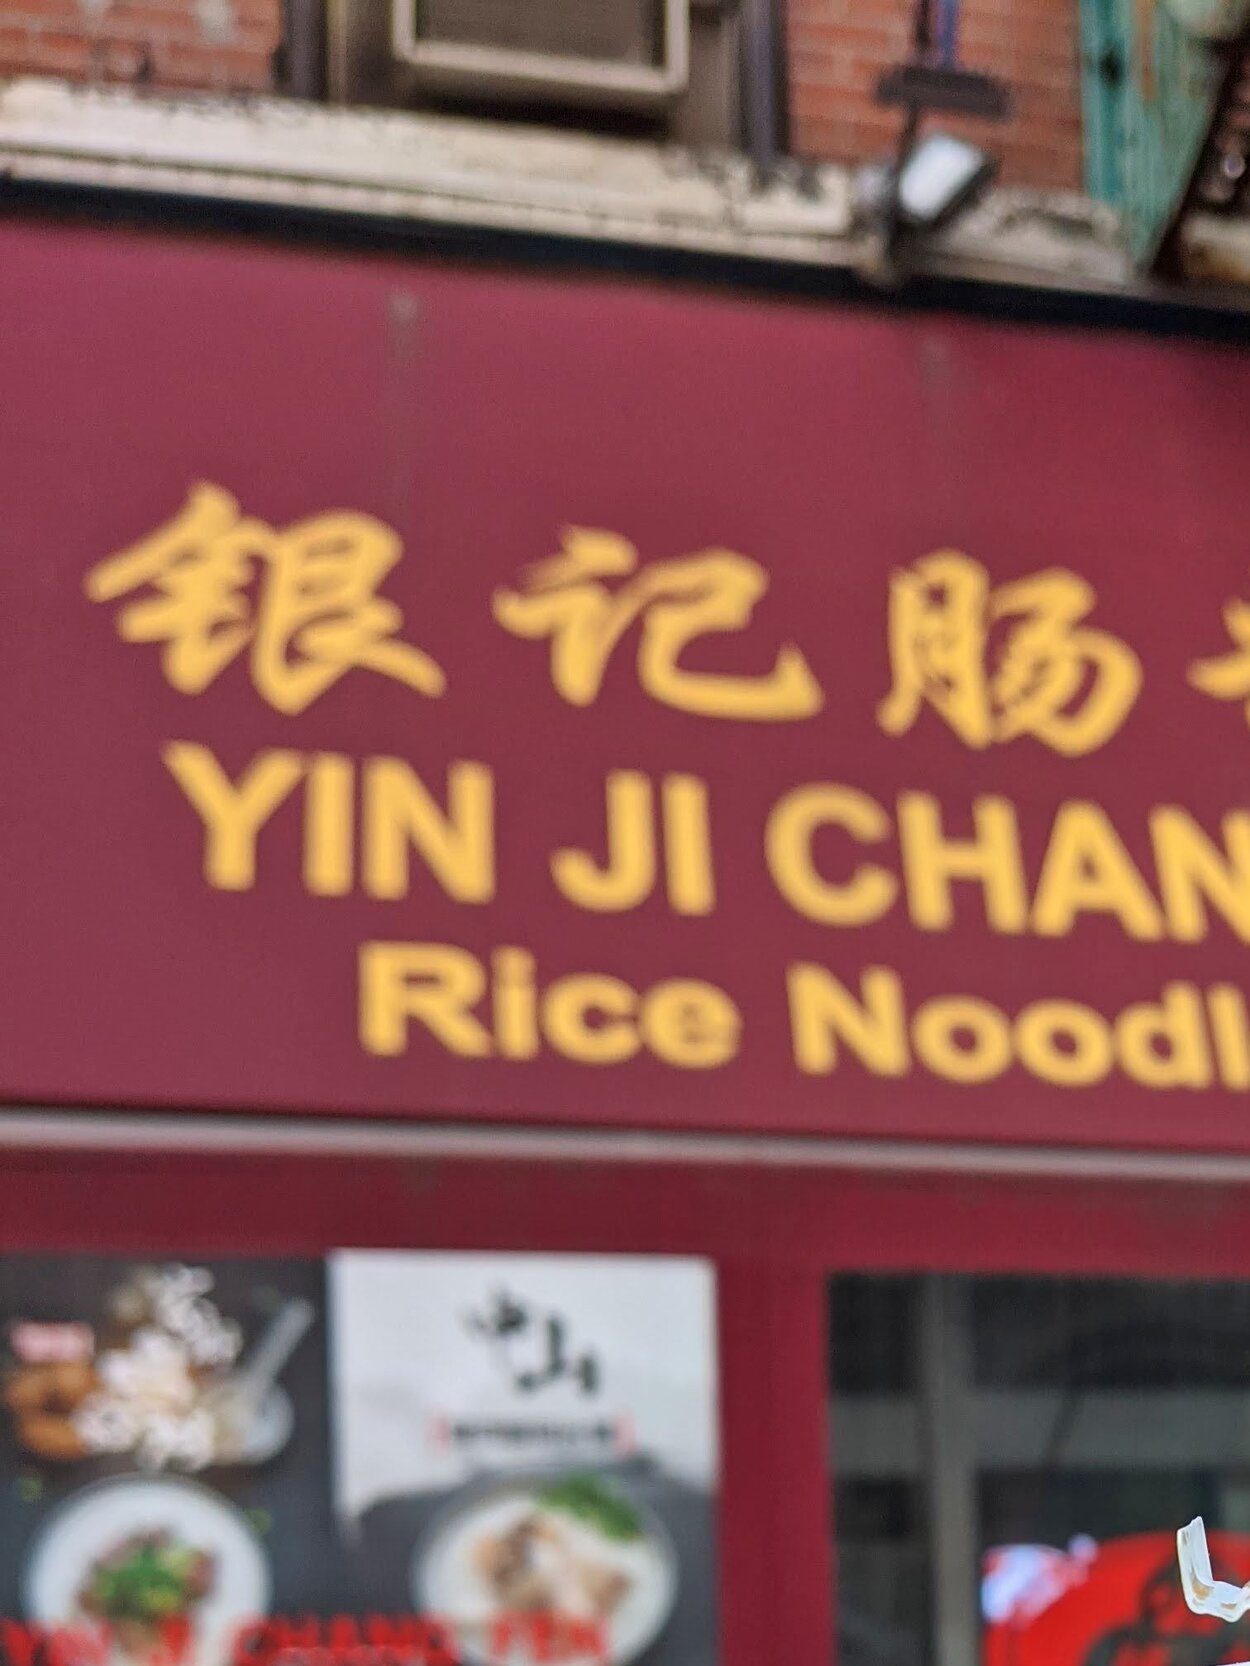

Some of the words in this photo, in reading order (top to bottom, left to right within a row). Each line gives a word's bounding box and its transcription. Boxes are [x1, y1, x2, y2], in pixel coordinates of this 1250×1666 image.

[165, 743, 495, 904] YIN
[552, 772, 715, 915] JI
[359, 942, 739, 1068] Rice
